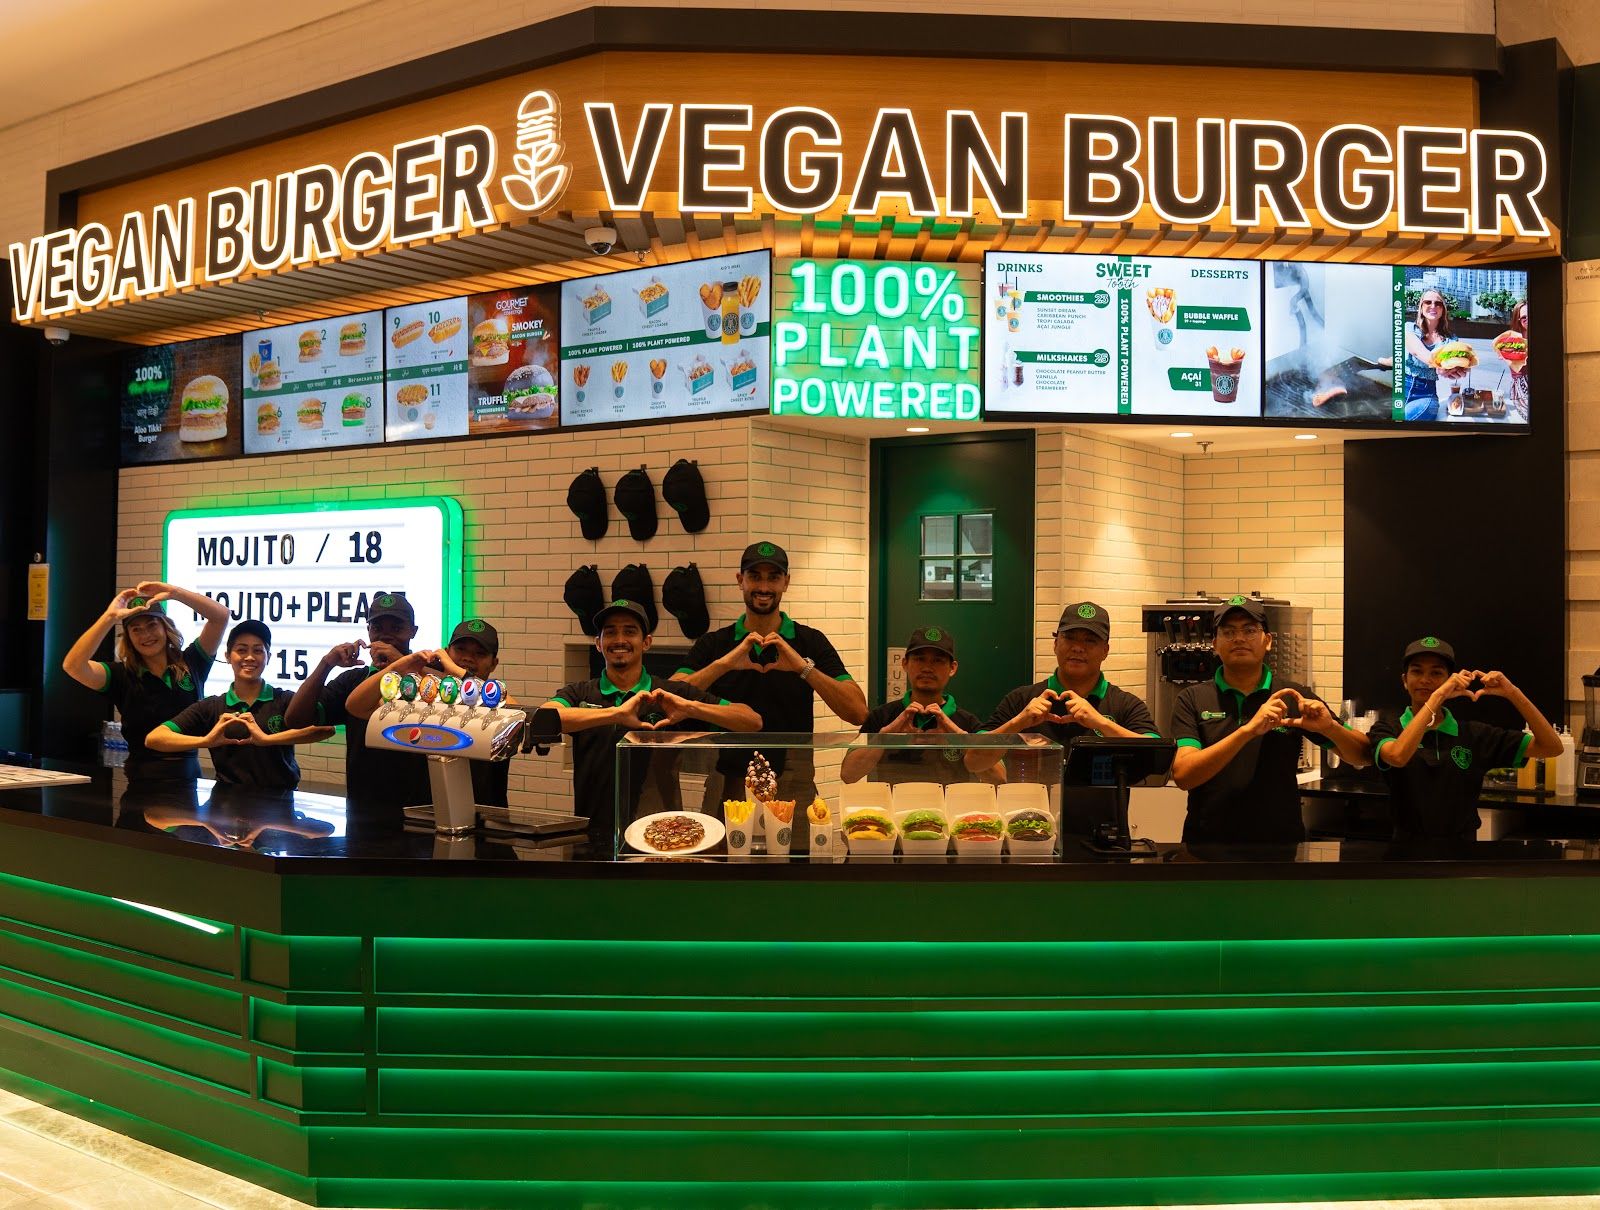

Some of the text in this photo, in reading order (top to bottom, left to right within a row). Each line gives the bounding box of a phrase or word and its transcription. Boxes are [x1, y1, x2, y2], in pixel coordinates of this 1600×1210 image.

[584, 101, 1551, 237] VEGAN BURGER
[9, 124, 499, 320] VEGAN BURGER
[997, 263, 1043, 273] DRINKS
[1096, 262, 1152, 278] SWEET
[1191, 269, 1249, 280] DESSERTS
[1106, 278, 1140, 289] Tooth
[791, 262, 965, 323] 100%
[1036, 293, 1085, 302] SMOOTHIES
[496, 296, 528, 311] GOURMET
[394, 316, 400, 329] 9
[429, 311, 441, 324] 10
[1184, 312, 1239, 321] BUBBLE WAFFLE
[361, 322, 367, 335] 3
[511, 319, 544, 332] SMOKEY
[321, 329, 327, 340] 2
[632, 335, 690, 349] 100% PLANT POWERED
[775, 321, 980, 371] PLANT
[1393, 300, 1403, 394] @VEGANBURGERUAE
[568, 344, 623, 357] 100% PLANT POWERED
[1120, 298, 1129, 405] 100% PLANT POWERED
[1036, 353, 1088, 363] MILKSHAKES
[135, 364, 163, 382] 100%
[1181, 371, 1202, 382] AÇAÍ
[430, 383, 441, 396] 11
[366, 396, 372, 409] 8
[478, 395, 508, 407] TRUFFLE
[773, 377, 981, 420] POWERED
[276, 407, 282, 418] 6
[322, 402, 327, 412] 7
[134, 423, 162, 435] Aloo Tikki
[138, 434, 158, 444] Burger
[197, 530, 383, 566] MOJITO / 18
[277, 649, 308, 681] 15
[892, 654, 901, 696] PUS
